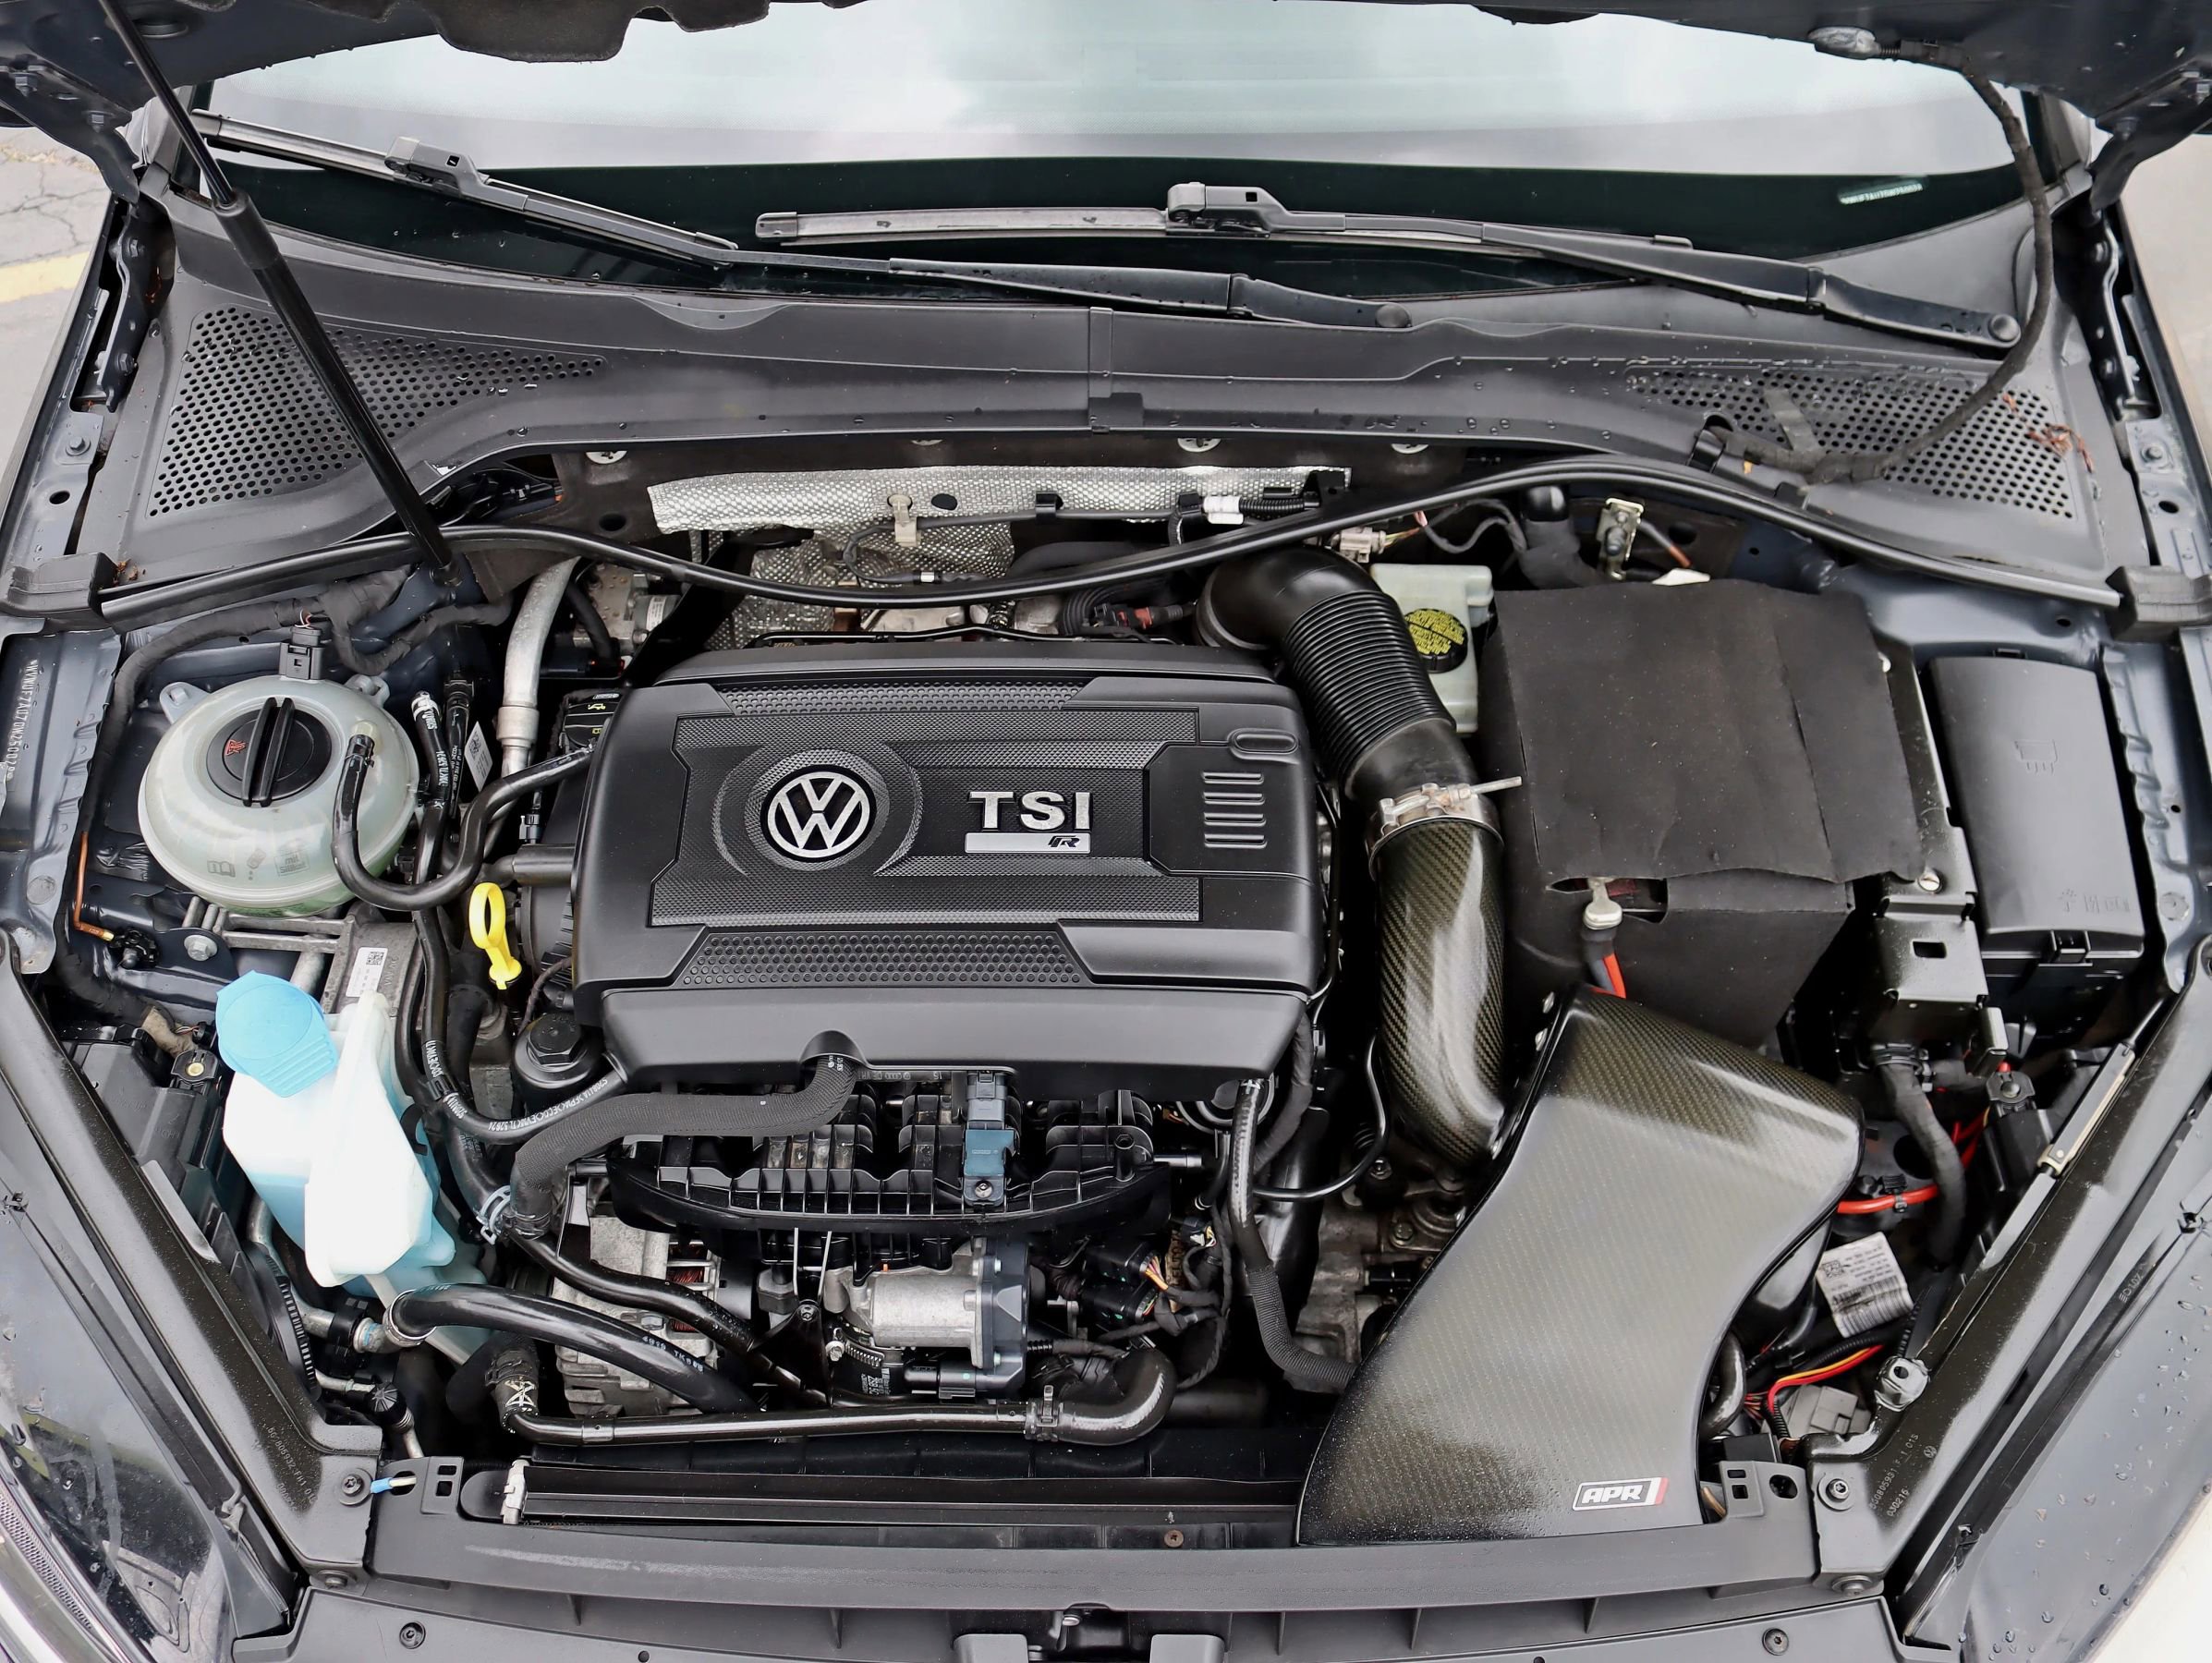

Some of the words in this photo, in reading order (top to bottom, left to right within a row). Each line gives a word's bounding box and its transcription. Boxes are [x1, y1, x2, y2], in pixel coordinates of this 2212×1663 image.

[970, 791, 1090, 830] TSI
[1582, 1485, 1643, 1503] APR
[1886, 1487, 1909, 1517] 030216
